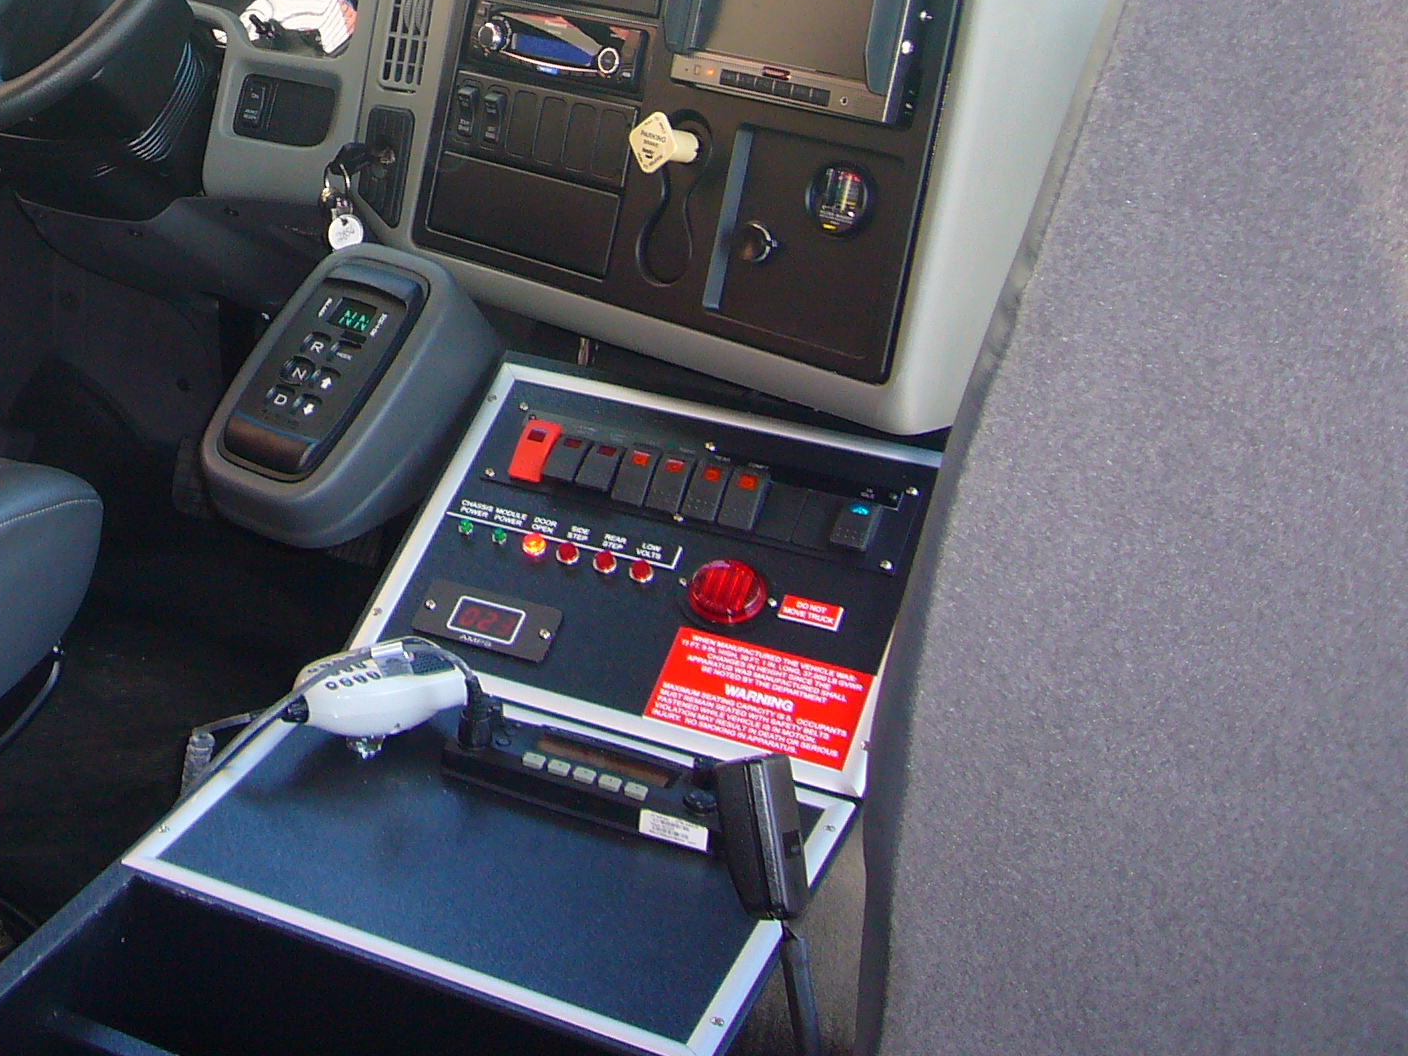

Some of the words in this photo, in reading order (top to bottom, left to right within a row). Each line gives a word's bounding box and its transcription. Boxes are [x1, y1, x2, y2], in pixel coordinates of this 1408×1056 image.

[640, 129, 666, 143] PARKING
[310, 340, 324, 354] R
[292, 367, 307, 380] N
[273, 393, 288, 405] D
[461, 499, 494, 512] CHASSIS
[460, 506, 489, 519] POWER
[495, 507, 528, 521] MODULE
[494, 514, 523, 526] POWER
[533, 516, 558, 528] DOOR
[531, 523, 554, 534] OPEN
[571, 525, 591, 536] SIDE
[567, 532, 589, 541] STEP
[604, 533, 627, 544] REAR
[602, 540, 624, 550] STEP
[642, 542, 662, 552] LOW
[636, 548, 662, 560] VOLTS
[796, 601, 809, 610] DO
[809, 604, 827, 614] NOT
[782, 606, 806, 619] MOVE
[808, 612, 834, 624] TRUCK
[692, 634, 715, 646] WHEN
[717, 640, 781, 663] MANUFACTURED
[782, 657, 798, 667] THE
[800, 661, 834, 676] VEHICLE
[687, 653, 733, 672] APPARATUS
[734, 666, 751, 677] WAS
[753, 671, 819, 695] MANUFACTURED
[820, 688, 847, 702] SHALL
[707, 652, 745, 668] CHANGES
[757, 665, 785, 678] HEIGHT
[788, 673, 812, 685] SINCE
[814, 680, 831, 690] THE
[713, 668, 741, 681] NOTED
[755, 678, 770, 689] THE
[771, 683, 826, 704] DEPARTMENT
[723, 683, 793, 713] WARNING
[657, 694, 699, 711] FASTENED
[700, 706, 725, 718] WHILE
[726, 713, 760, 728] VEHICLE
[659, 687, 682, 700] MUST
[683, 694, 714, 708] REMAIN
[715, 703, 746, 717] SEATED
[748, 711, 768, 723] WITH
[770, 717, 801, 732] SAFETY
[803, 726, 829, 740] BELTS
[662, 681, 699, 697] MAXIMUM
[701, 691, 734, 707] SEATING
[736, 701, 773, 717] CAPACITY
[796, 717, 847, 737] OCCUPANTS
[654, 700, 696, 718] VIOLATION
[697, 712, 714, 723] MAY
[715, 717, 746, 732] RESULT
[757, 729, 784, 742] DEATH
[800, 740, 838, 757] SERIOUS
[698, 720, 735, 737] SMOKING
